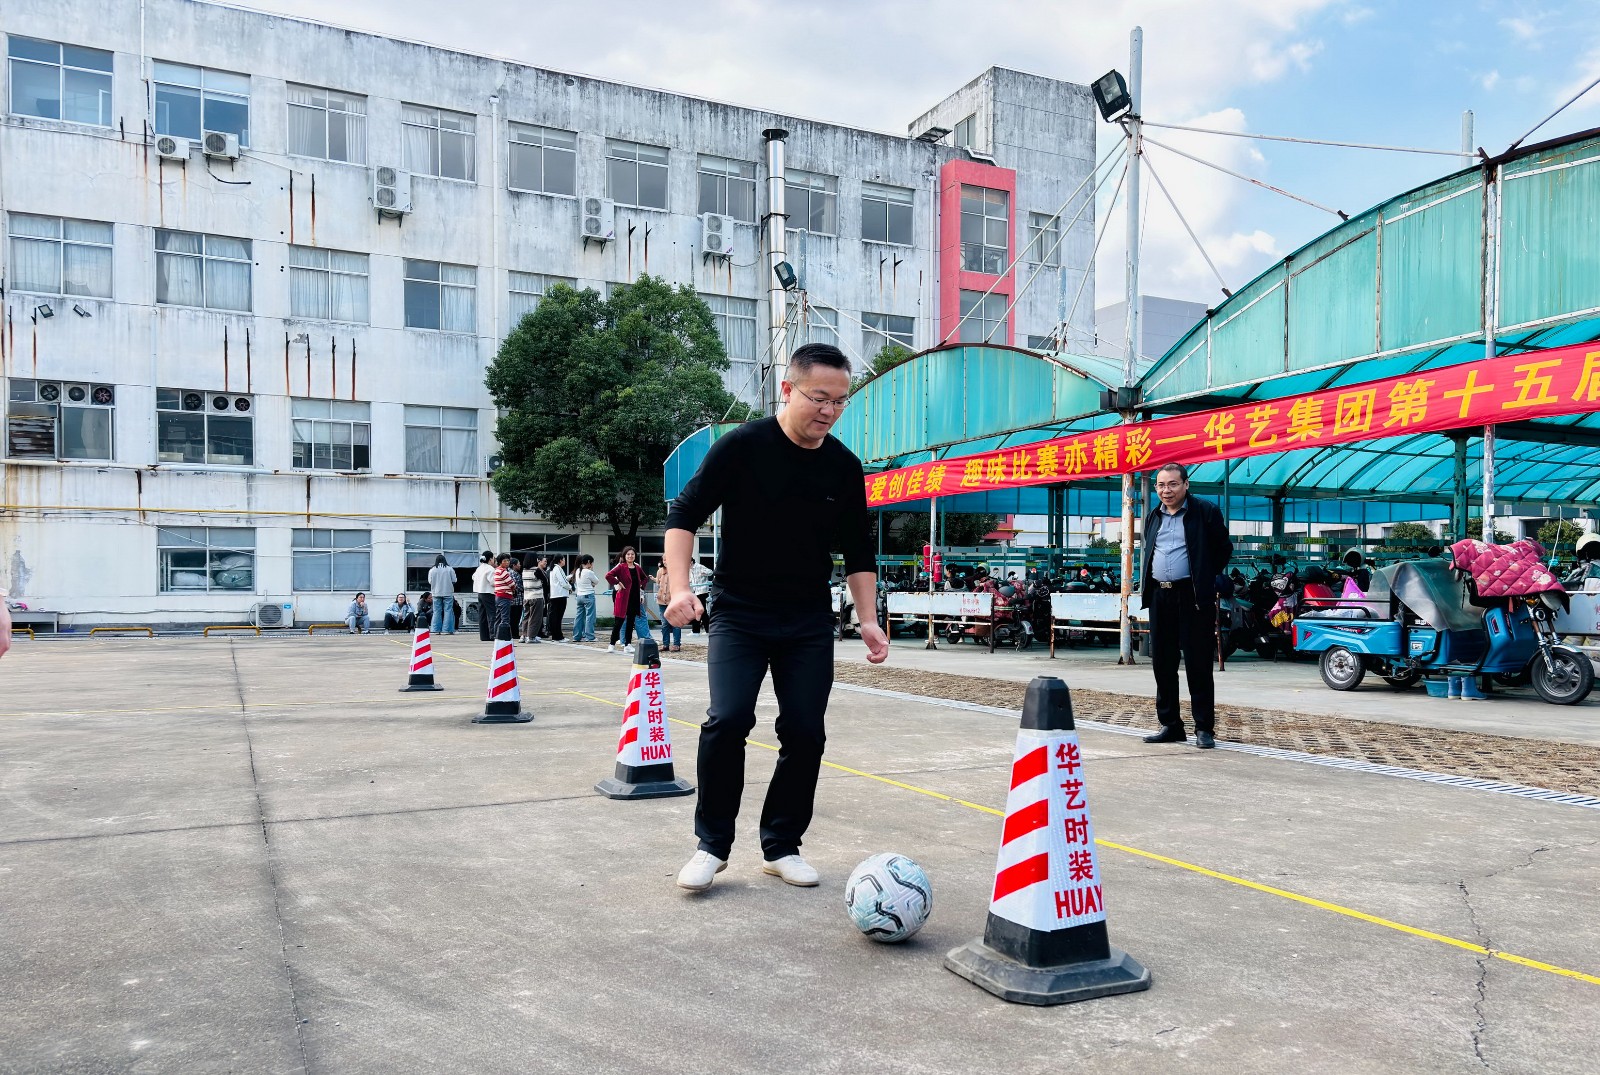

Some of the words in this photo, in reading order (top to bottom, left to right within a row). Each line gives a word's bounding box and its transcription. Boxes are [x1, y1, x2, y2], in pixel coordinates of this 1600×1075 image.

[865, 463, 947, 502] 爱创佳绩
[644, 671, 665, 743] 华艺时装
[640, 743, 672, 761] HUAY
[1055, 742, 1094, 883] 华艺时装
